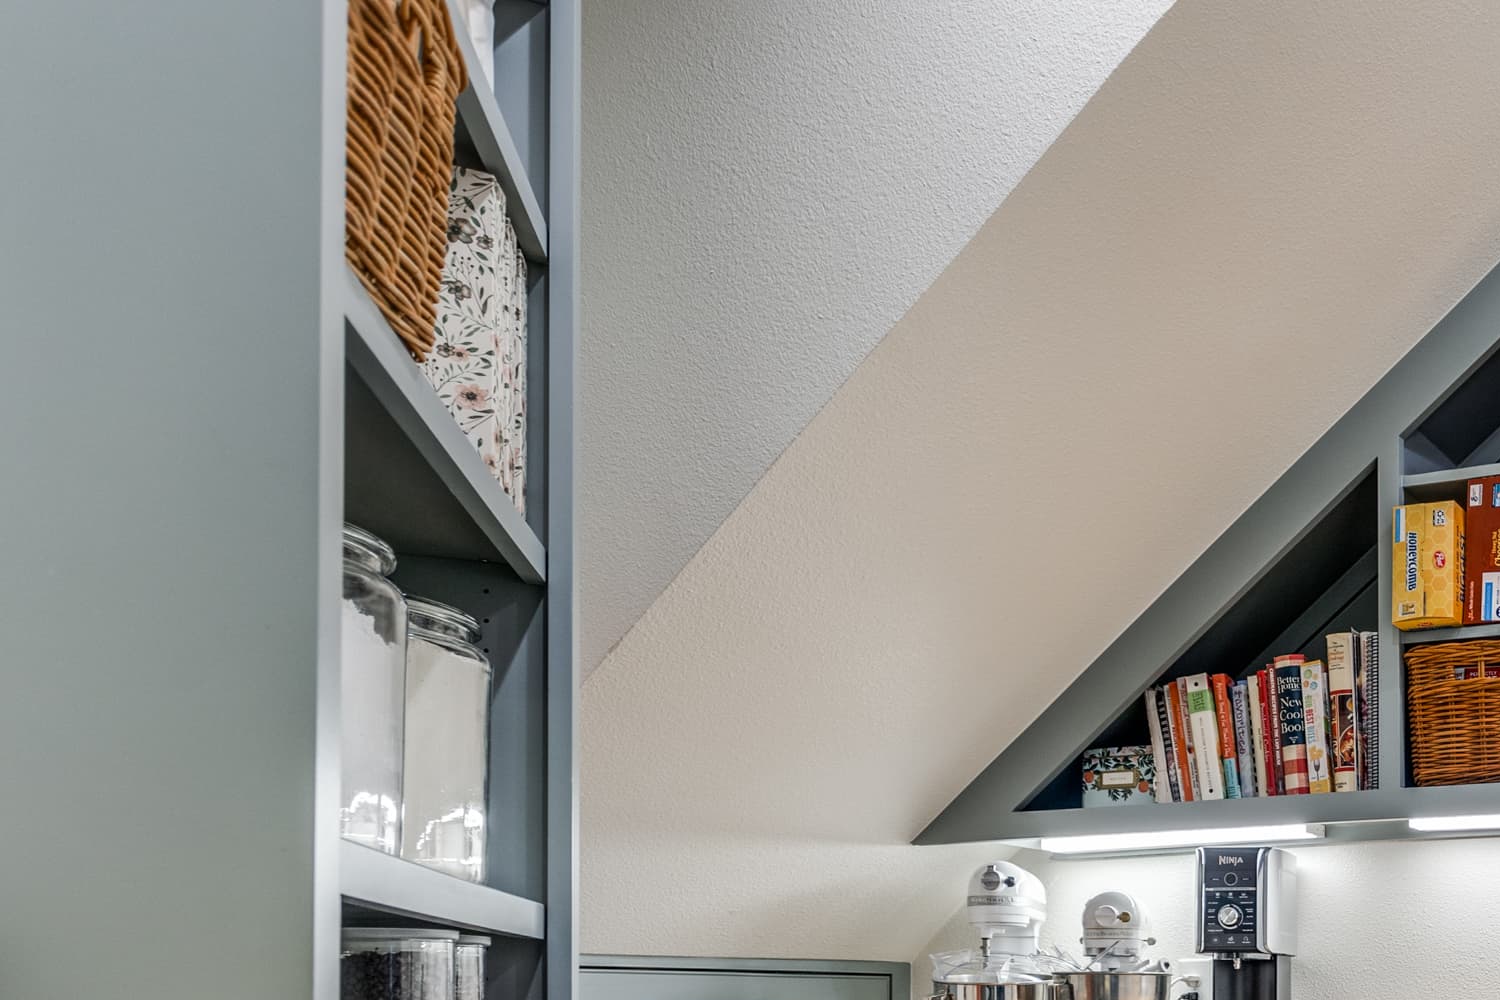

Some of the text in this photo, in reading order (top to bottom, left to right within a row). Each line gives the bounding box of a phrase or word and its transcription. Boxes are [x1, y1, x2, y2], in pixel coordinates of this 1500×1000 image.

[1278, 681, 1301, 694] Home
[1280, 696, 1303, 709] New
[1305, 708, 1315, 725] BEST
[1218, 855, 1244, 867] NINJA
